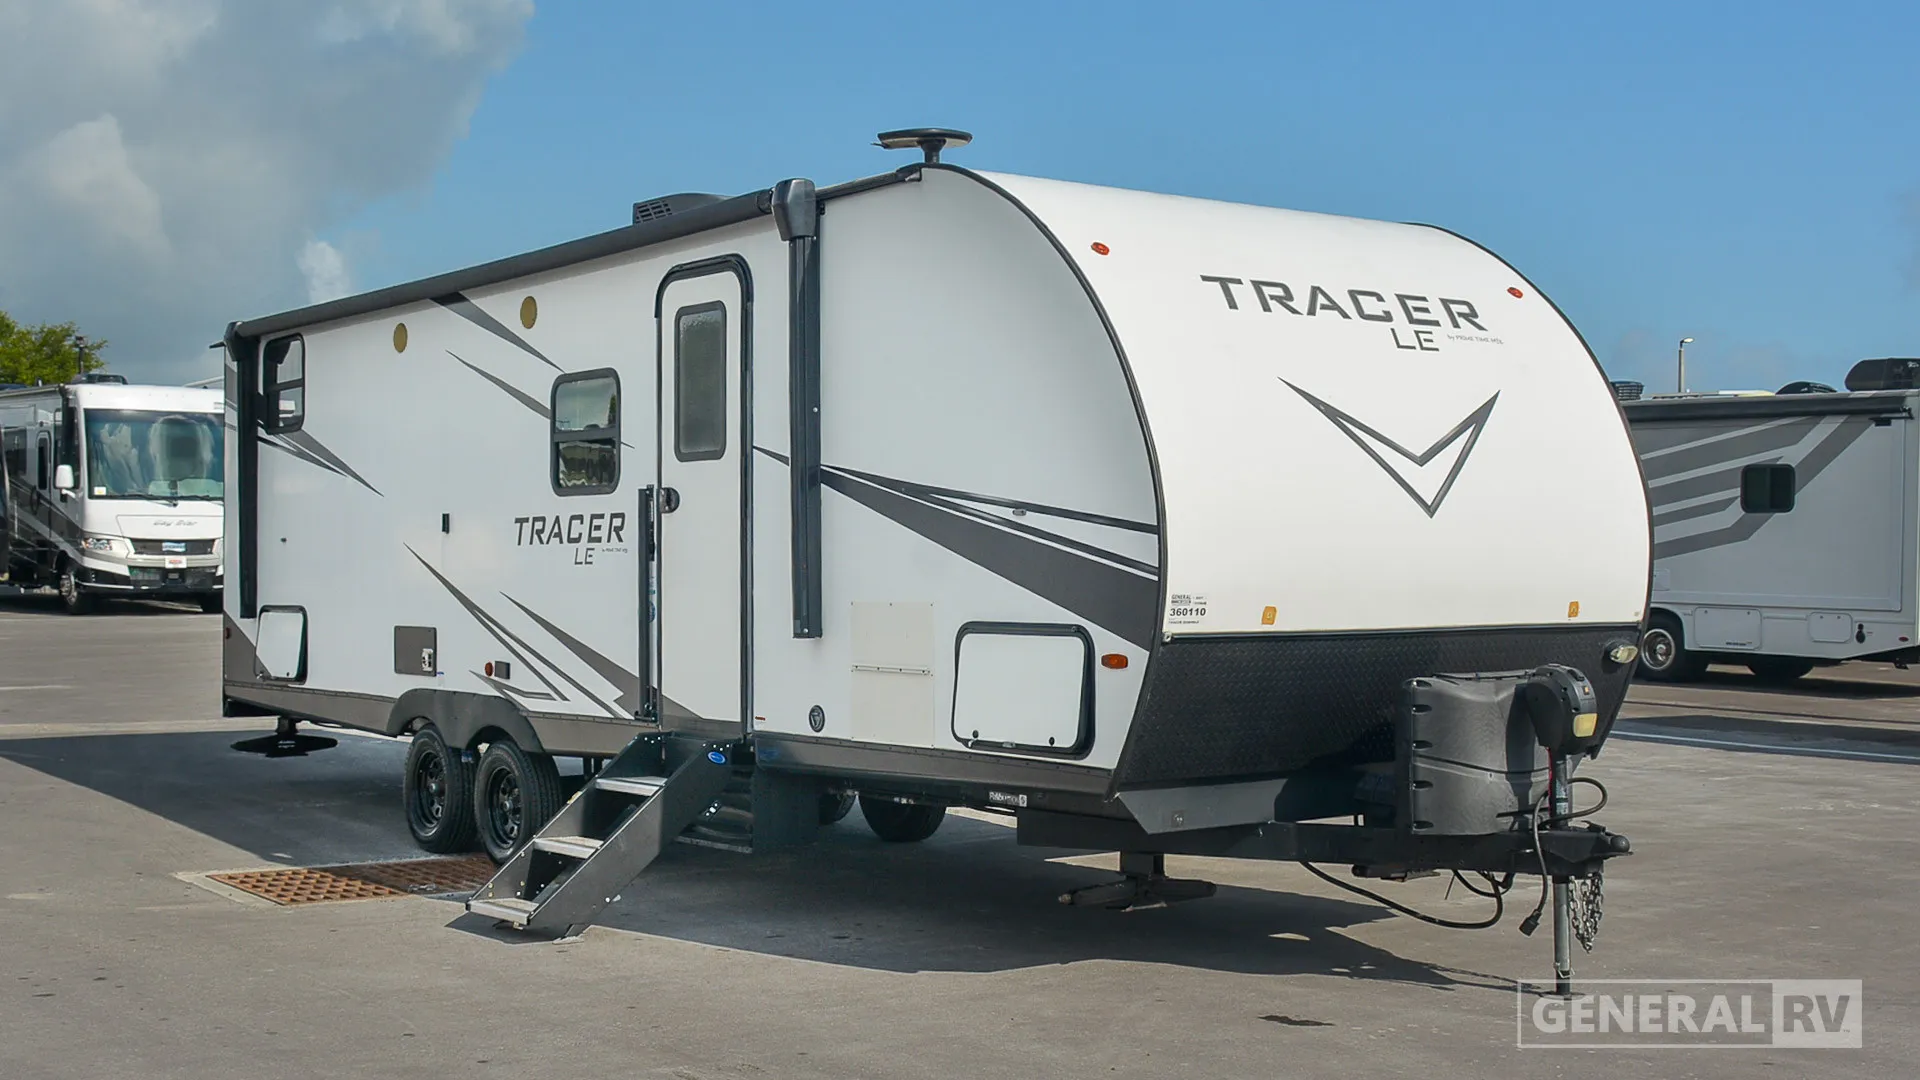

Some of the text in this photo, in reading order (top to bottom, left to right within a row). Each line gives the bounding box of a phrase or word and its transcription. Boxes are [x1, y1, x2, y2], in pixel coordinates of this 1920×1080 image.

[1200, 274, 1489, 332] TRACER
[1390, 328, 1440, 352] LE
[514, 512, 626, 546] TRACER
[574, 547, 596, 566] LE
[1169, 607, 1206, 617] 360110
